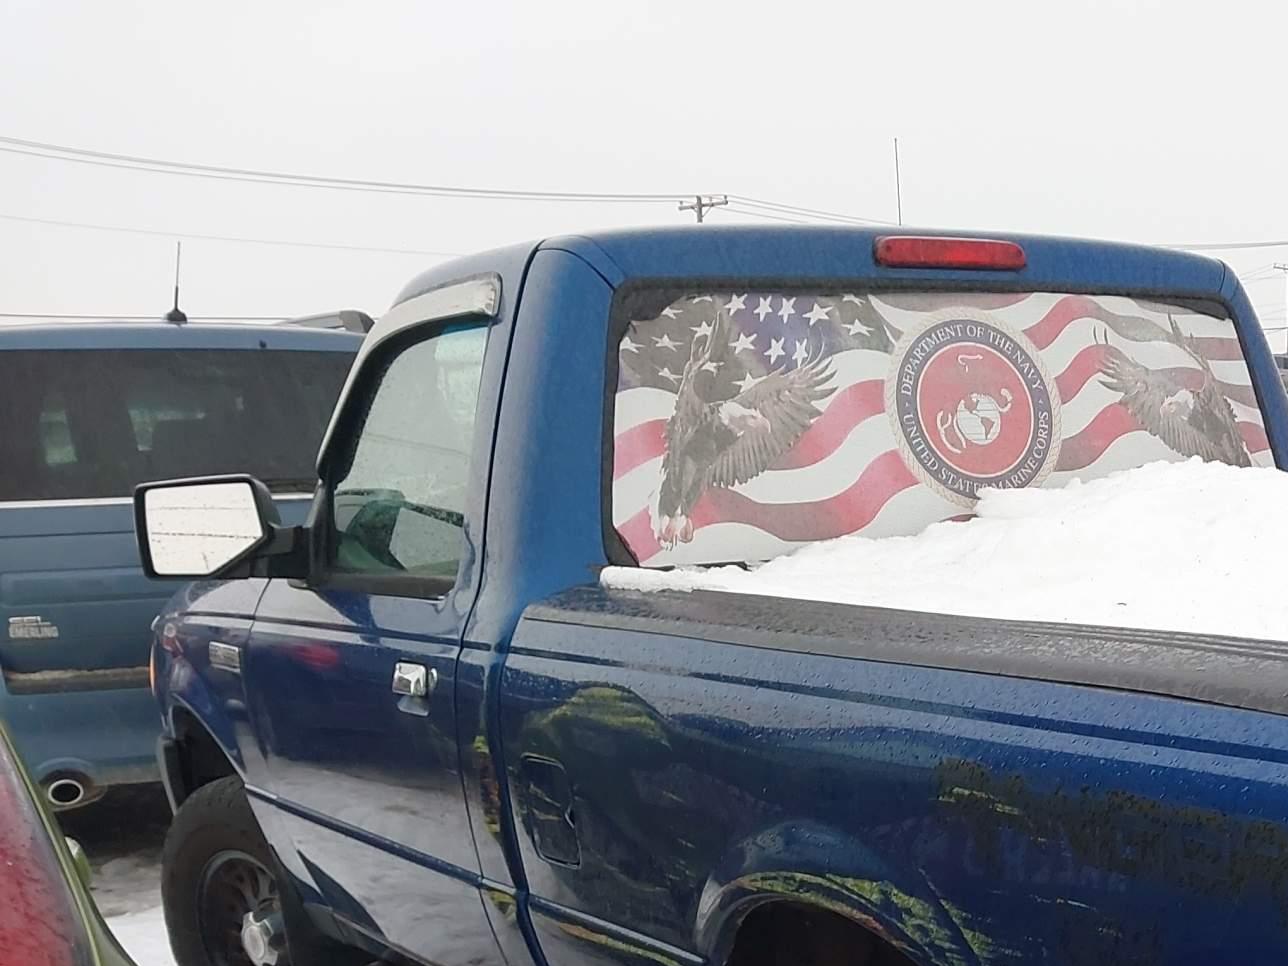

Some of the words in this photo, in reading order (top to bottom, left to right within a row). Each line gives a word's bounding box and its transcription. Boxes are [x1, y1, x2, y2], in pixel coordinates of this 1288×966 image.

[901, 324, 963, 396] DEPARTMENT
[966, 324, 985, 338] OF
[988, 330, 1014, 354] THE
[1015, 350, 1043, 391] NAVY
[903, 413, 939, 471] UNITED
[1035, 411, 1049, 459] CORPS
